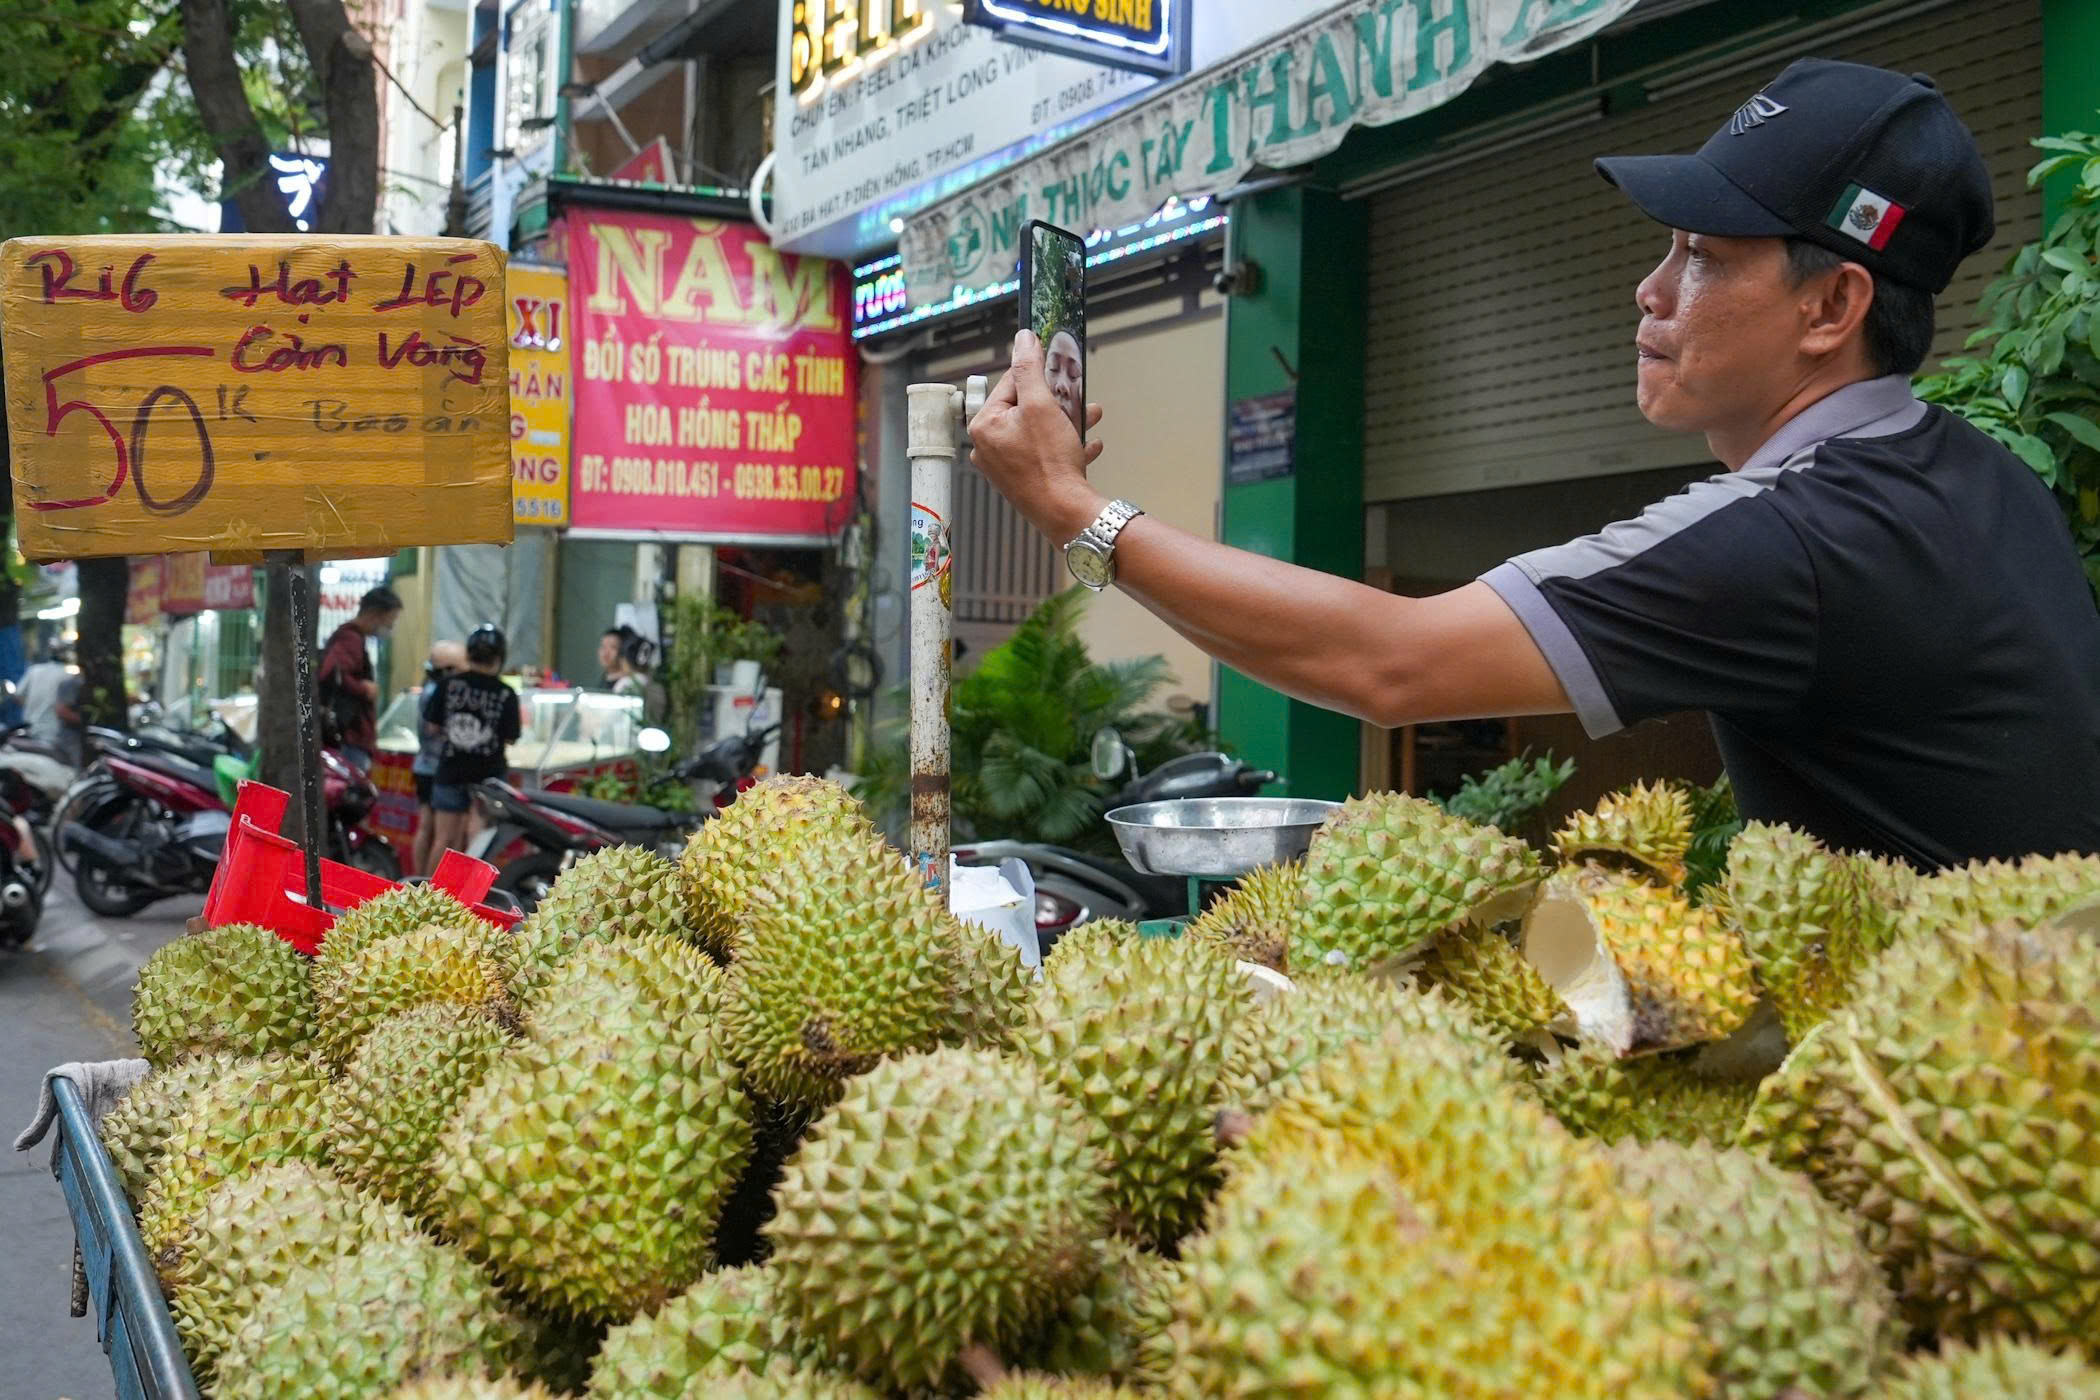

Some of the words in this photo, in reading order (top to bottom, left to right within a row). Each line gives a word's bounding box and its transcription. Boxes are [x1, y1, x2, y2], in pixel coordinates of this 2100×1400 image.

[857, 68, 896, 99] PEEL
[900, 53, 920, 80] DA
[946, 57, 998, 104] LONG
[1200, 0, 1474, 175] THANH
[587, 217, 842, 335] NĂM
[629, 329, 663, 384] SỐ
[666, 337, 741, 391] TRÚNG
[746, 344, 790, 394] CÁC
[794, 343, 844, 397] TỈNH
[625, 402, 673, 447] HOA
[677, 393, 742, 449] HỒNG
[746, 398, 802, 452] THẤP
[512, 458, 559, 483] NG
[581, 454, 608, 493] ĐT:
